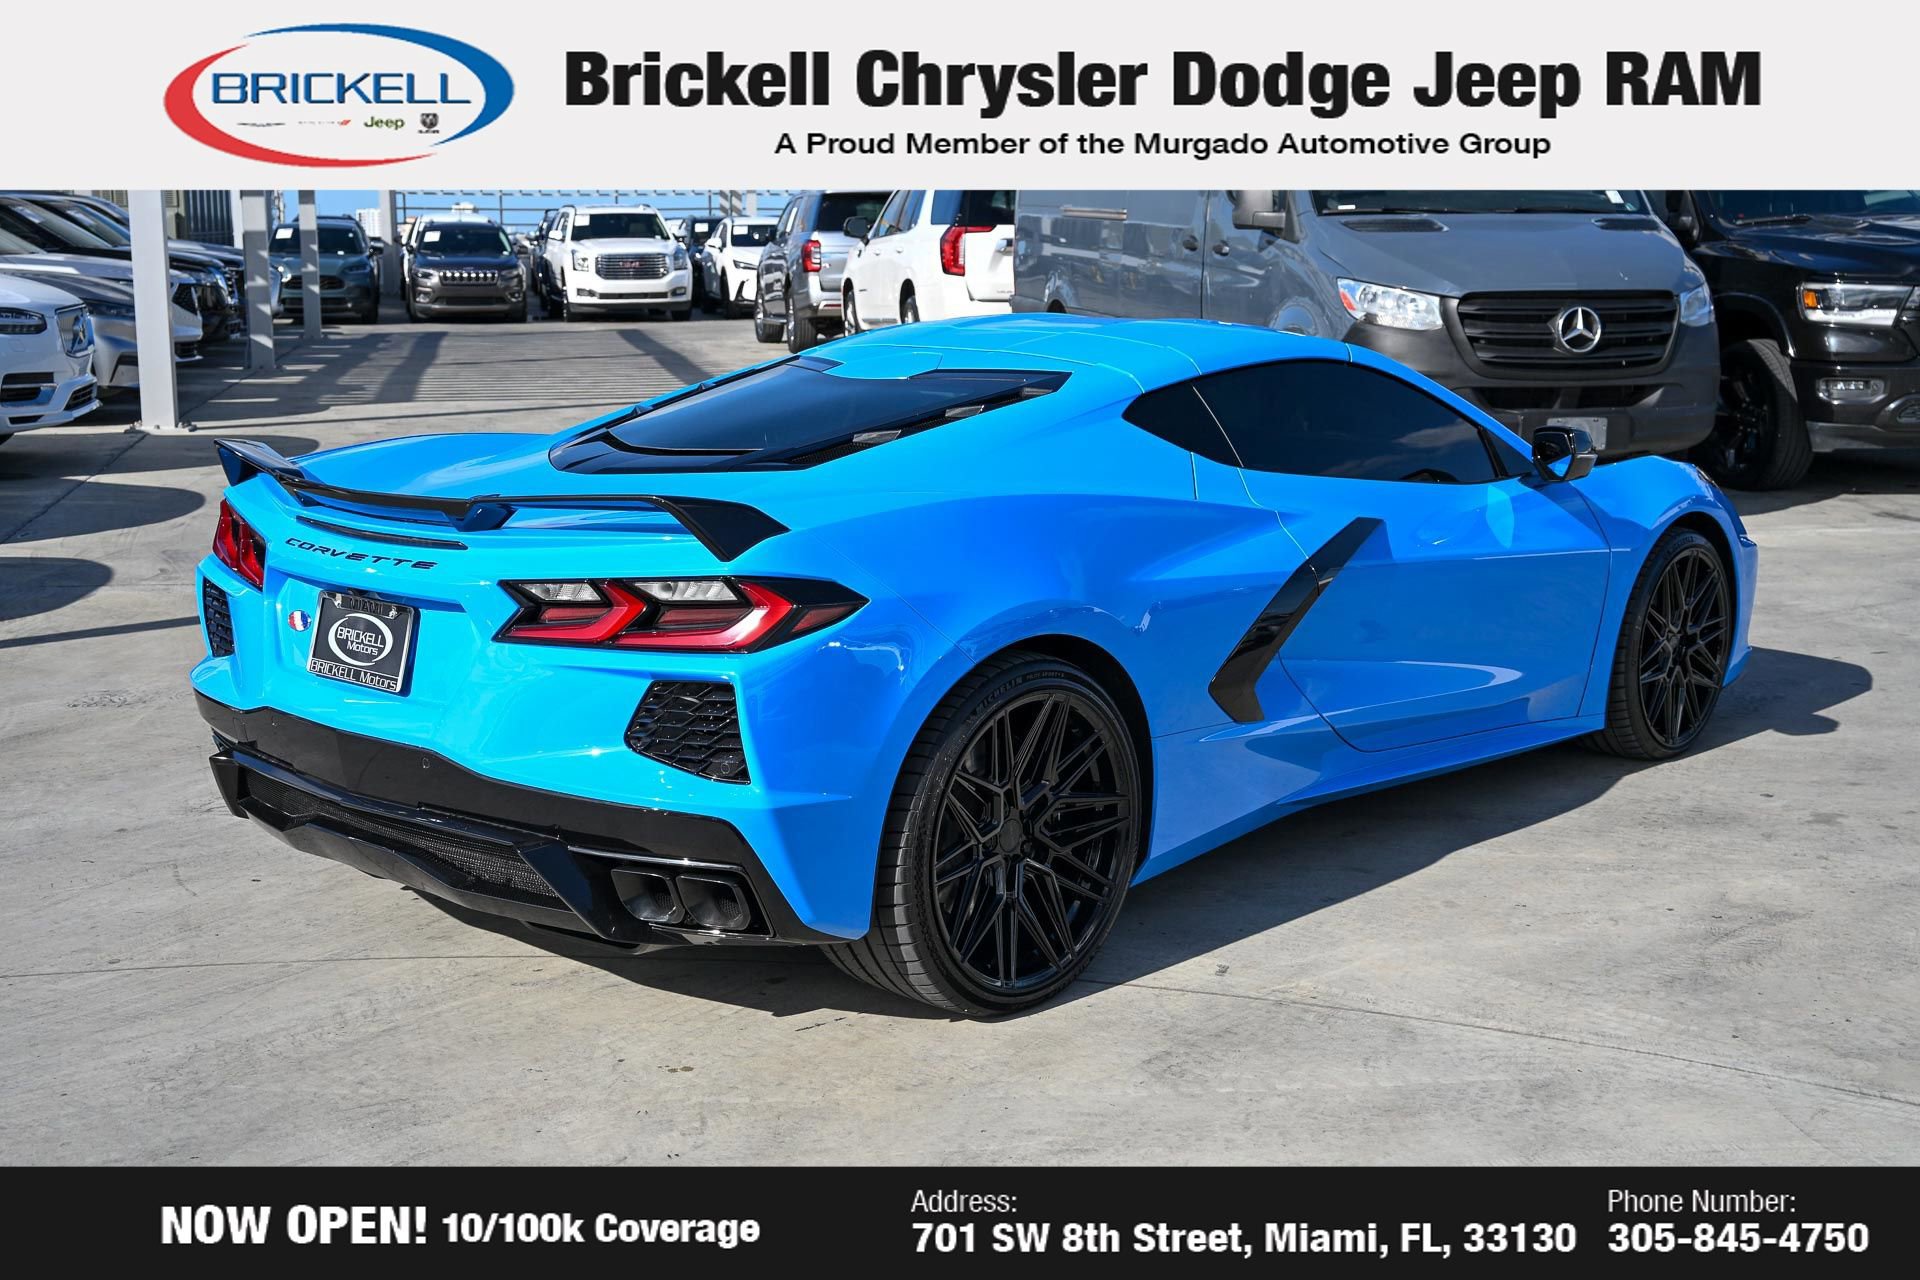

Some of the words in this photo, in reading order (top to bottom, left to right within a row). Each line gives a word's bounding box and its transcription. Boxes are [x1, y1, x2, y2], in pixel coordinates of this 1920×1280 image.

[285, 537, 438, 570] CORVETTE
[336, 626, 384, 648] BRICKELL
[346, 640, 379, 656] Motors
[310, 659, 356, 682] BRICKELL
[359, 672, 397, 690] Motors
